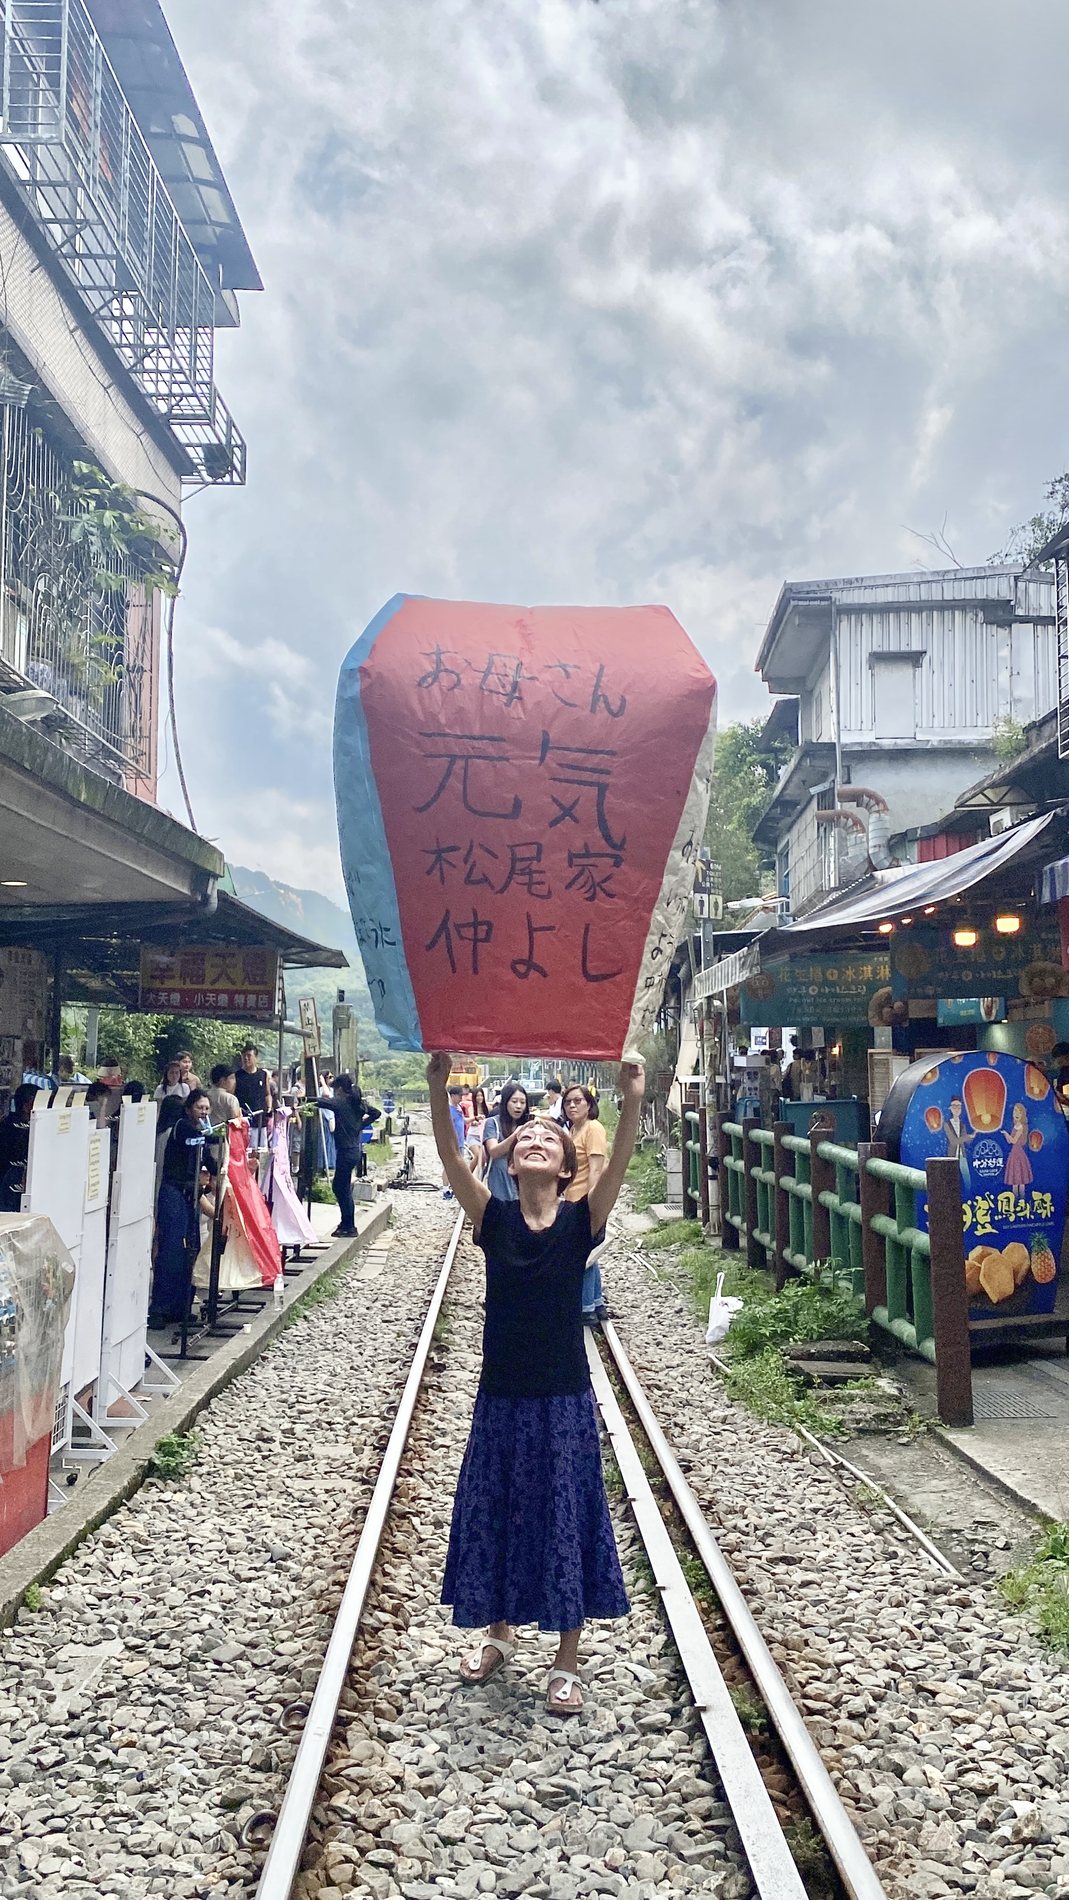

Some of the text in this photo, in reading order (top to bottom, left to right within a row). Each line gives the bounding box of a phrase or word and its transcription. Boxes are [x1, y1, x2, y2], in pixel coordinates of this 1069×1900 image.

[415, 644, 627, 719] お母さん
[412, 730, 627, 851] 元気
[417, 838, 627, 901] 松尾家
[424, 906, 623, 983] 仲よし
